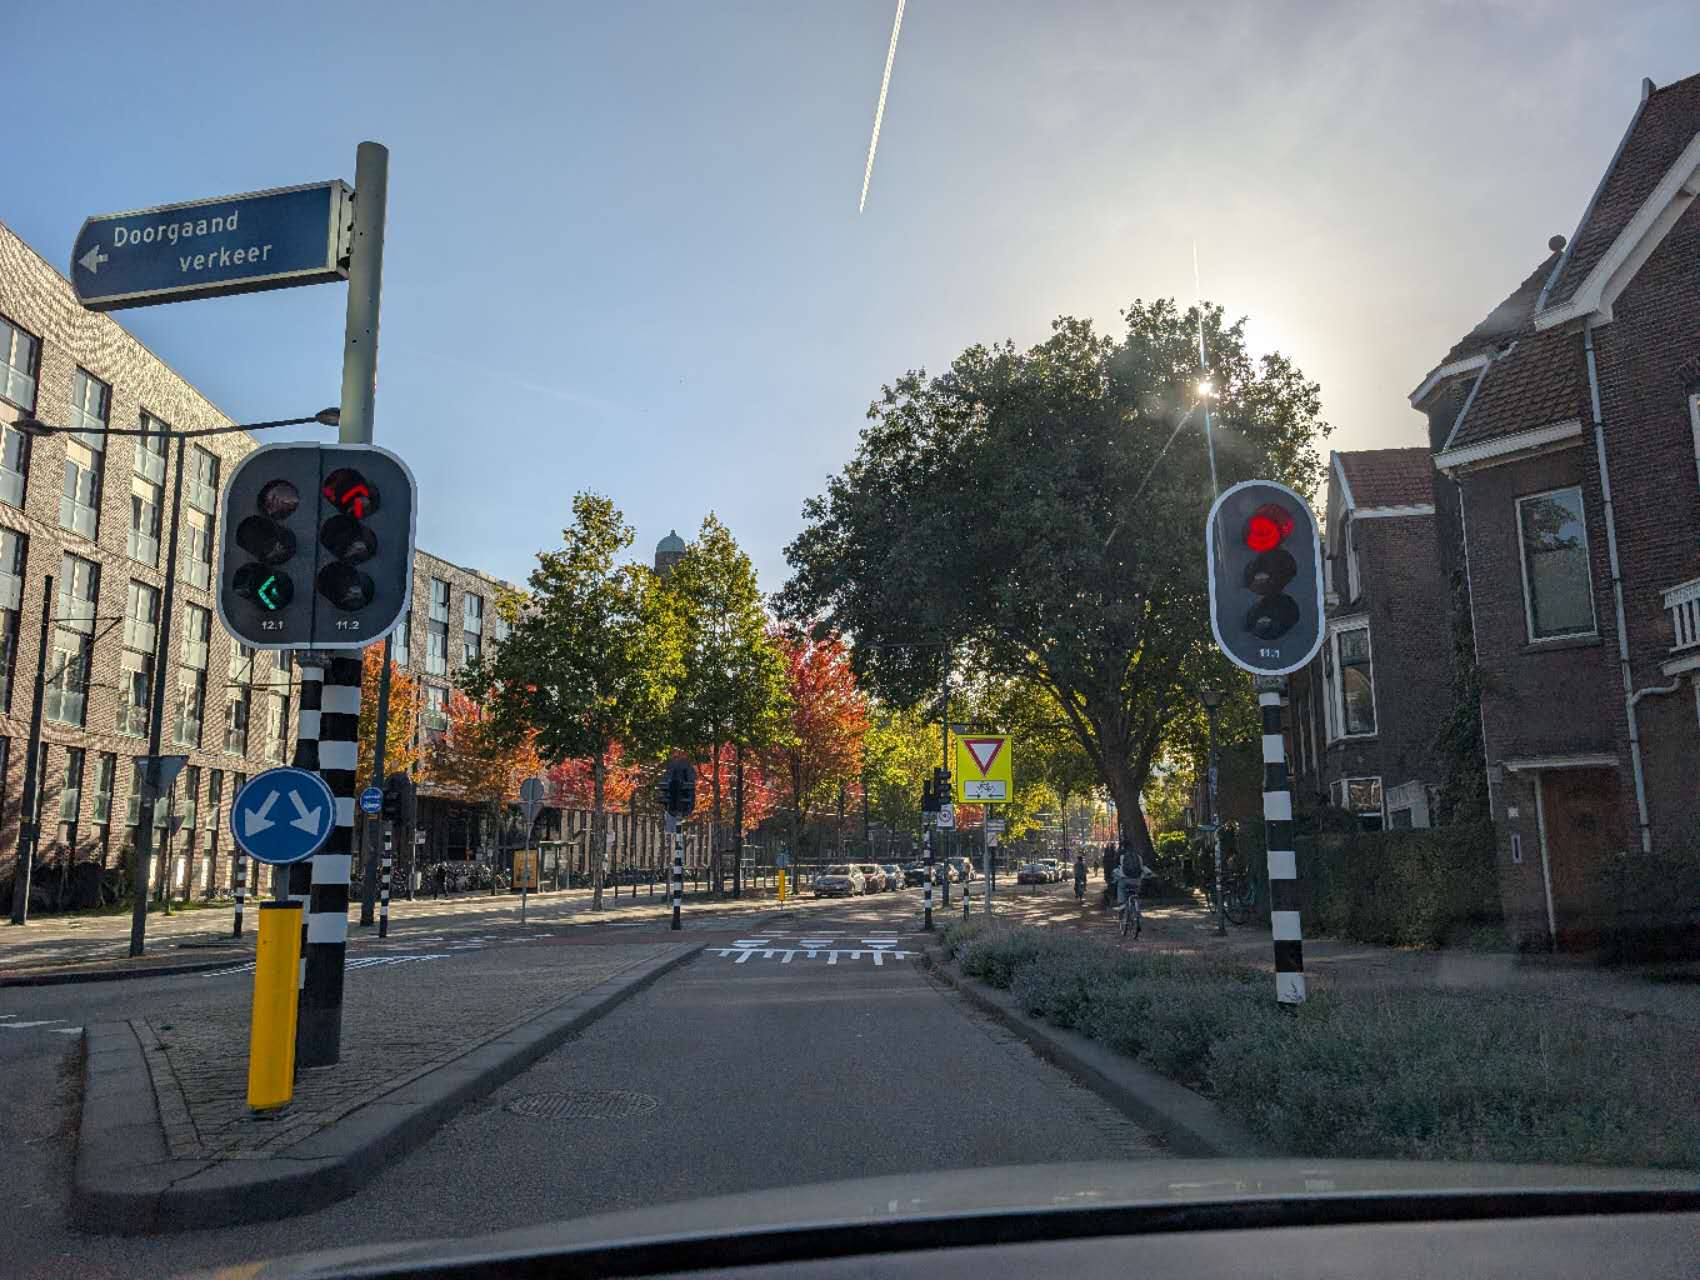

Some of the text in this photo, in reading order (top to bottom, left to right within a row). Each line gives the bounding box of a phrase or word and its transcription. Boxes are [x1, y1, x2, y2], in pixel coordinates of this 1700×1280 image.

[114, 210, 239, 247] Doorgaand
[179, 244, 273, 272] verkeer
[262, 620, 284, 630] 12.1
[336, 620, 360, 630] 11.2
